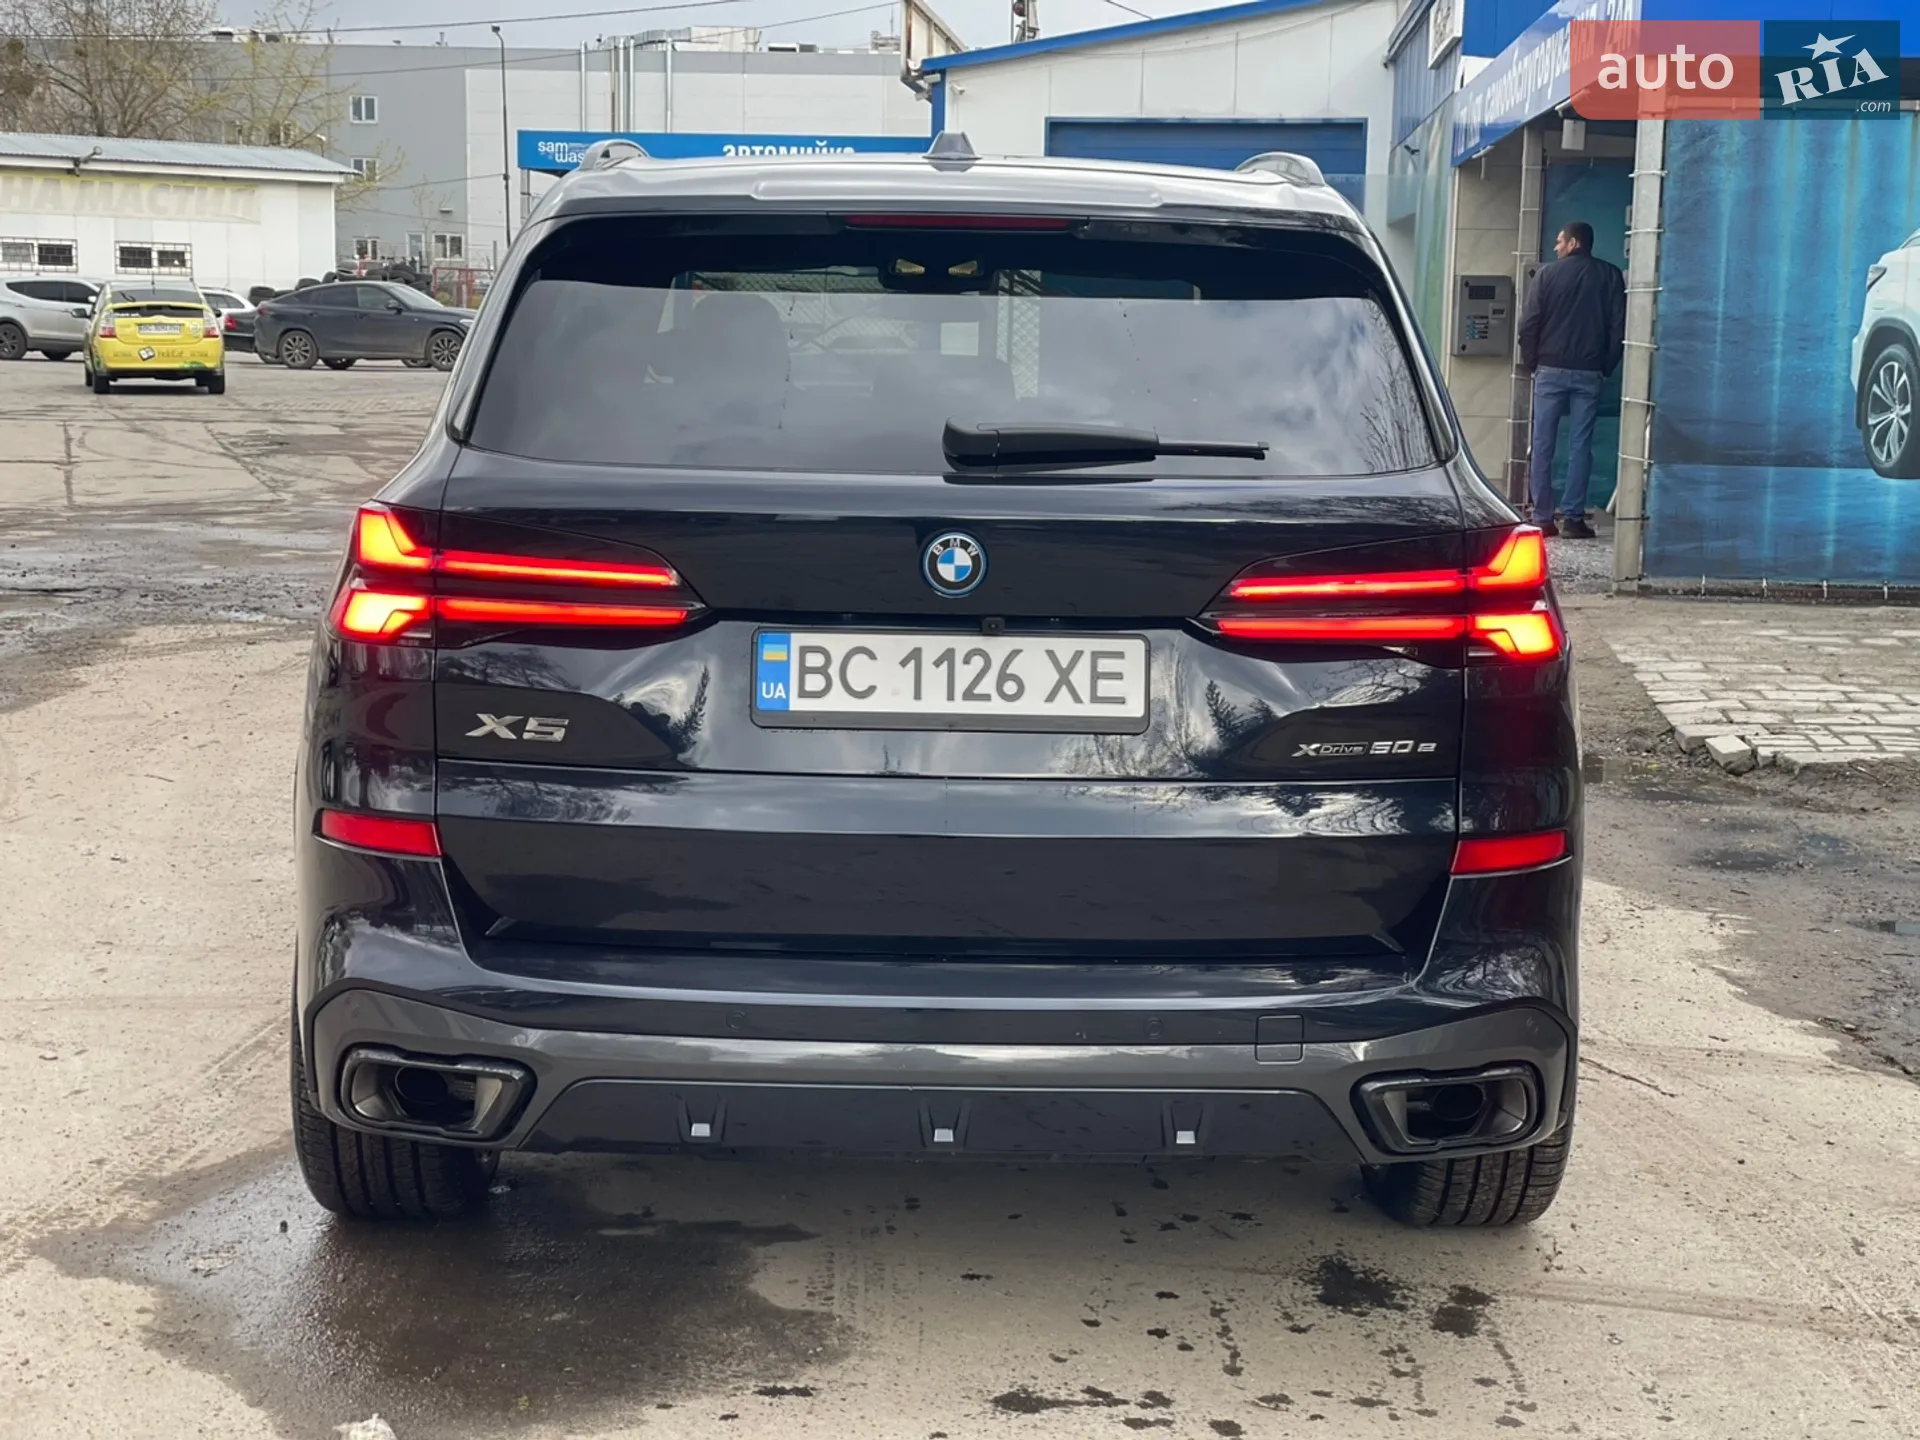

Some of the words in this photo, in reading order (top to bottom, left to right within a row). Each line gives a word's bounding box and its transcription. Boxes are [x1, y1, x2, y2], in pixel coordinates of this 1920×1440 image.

[537, 141, 568, 152] sam
[554, 149, 585, 163] was
[932, 538, 979, 557] BMW
[797, 645, 878, 699] BC
[898, 646, 1026, 702] 1126
[1043, 649, 1126, 704] XE
[762, 682, 787, 698] UA
[464, 713, 569, 742] X5
